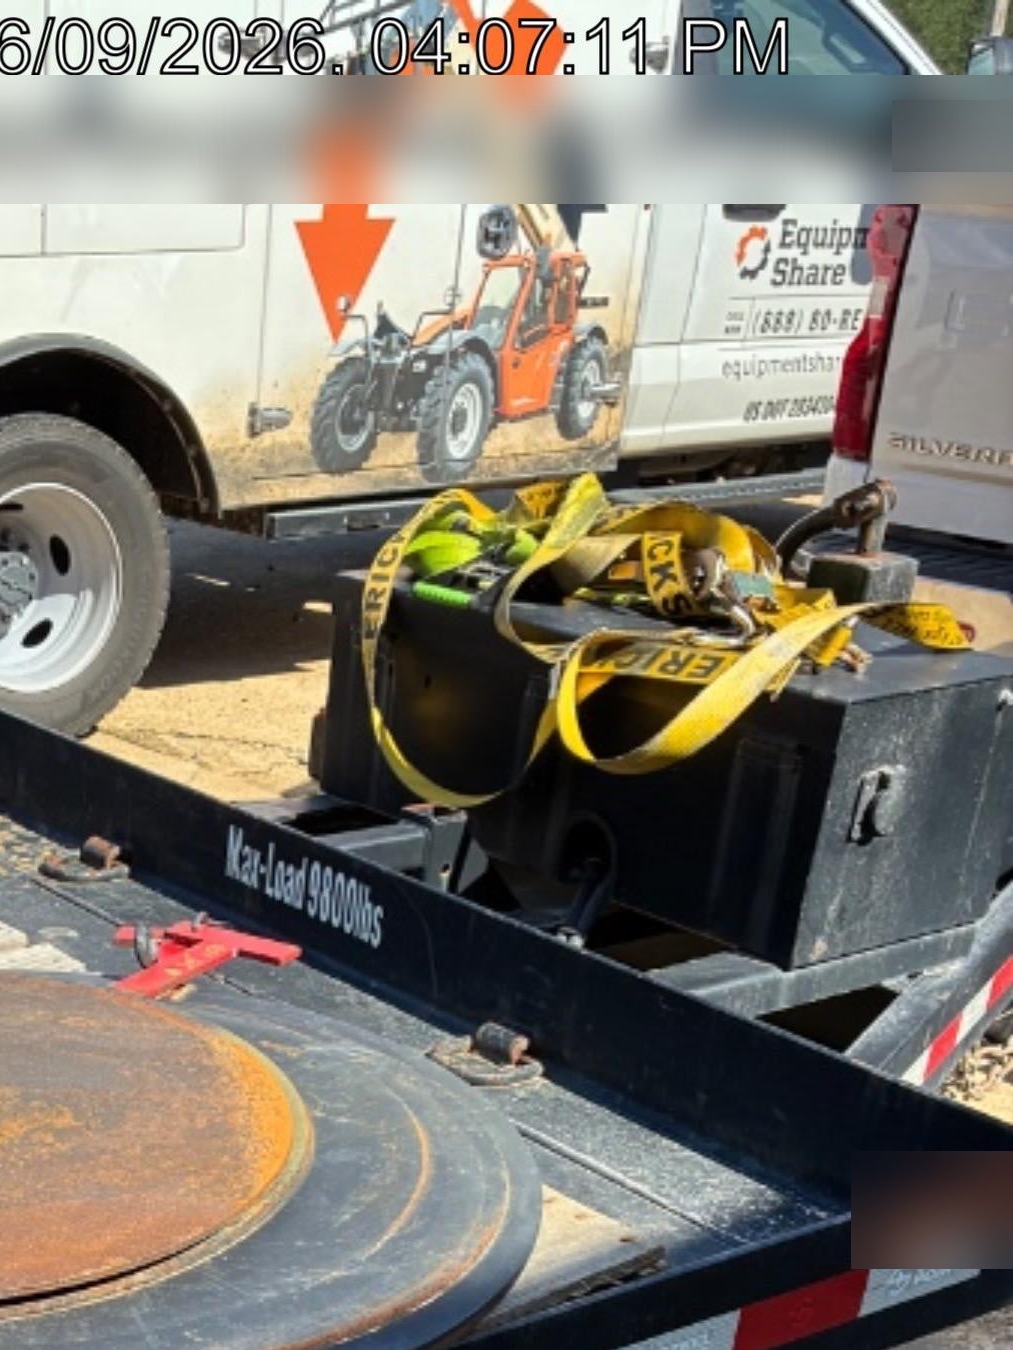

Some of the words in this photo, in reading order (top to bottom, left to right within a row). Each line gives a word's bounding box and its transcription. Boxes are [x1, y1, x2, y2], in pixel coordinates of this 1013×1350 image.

[770, 257, 846, 286] Share
[225, 824, 309, 910] Max-Load
[306, 860, 384, 948] 9800lbs
